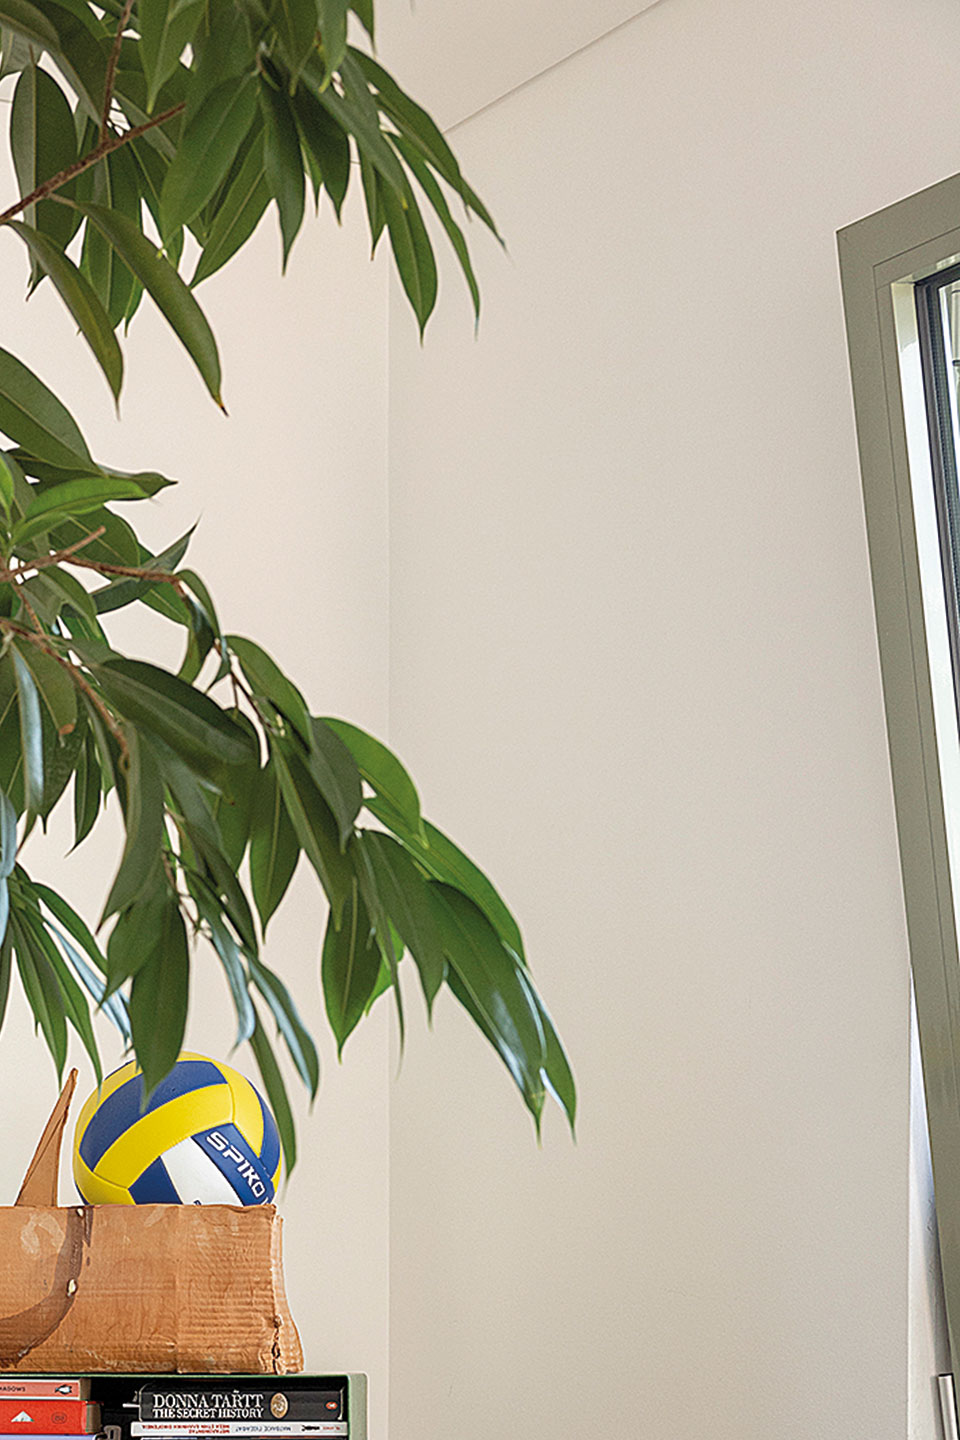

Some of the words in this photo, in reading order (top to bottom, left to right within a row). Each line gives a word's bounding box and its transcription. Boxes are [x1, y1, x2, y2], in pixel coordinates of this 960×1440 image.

[206, 1131, 265, 1198] SPIKO
[153, 1394, 209, 1408] DONNA
[211, 1394, 264, 1408] TARTT
[153, 1408, 175, 1418] THE
[177, 1408, 217, 1418] SECRET
[218, 1408, 264, 1418] HISTORY
